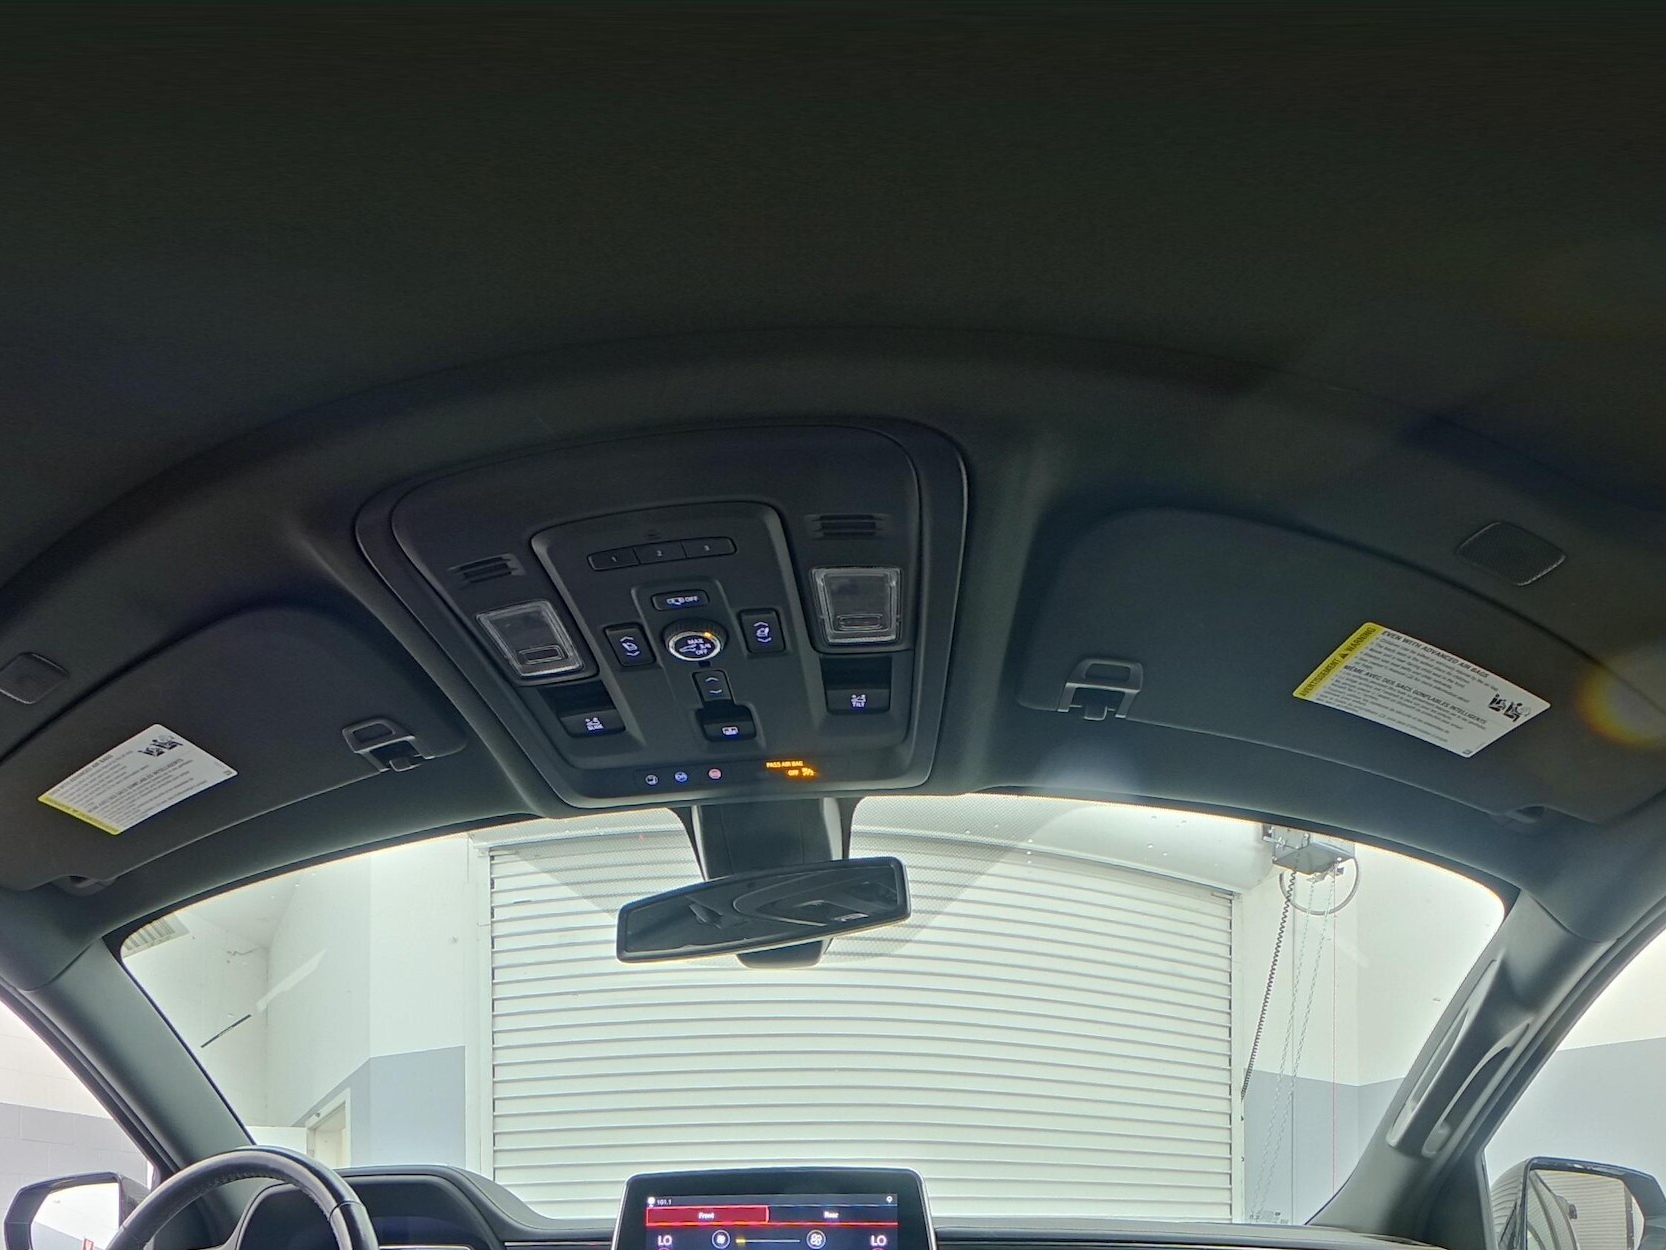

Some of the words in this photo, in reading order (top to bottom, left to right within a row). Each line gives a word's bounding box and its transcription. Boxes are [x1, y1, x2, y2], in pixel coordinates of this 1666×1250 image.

[1346, 627, 1376, 652] WARNING
[1381, 629, 1402, 641] EVEN
[1401, 637, 1422, 648] WITH
[1421, 645, 1459, 664] ADVANCED
[1457, 661, 1472, 669] AIR
[1469, 667, 1490, 678] BAGS
[657, 1235, 673, 1246] LO
[870, 1235, 887, 1246] LO
